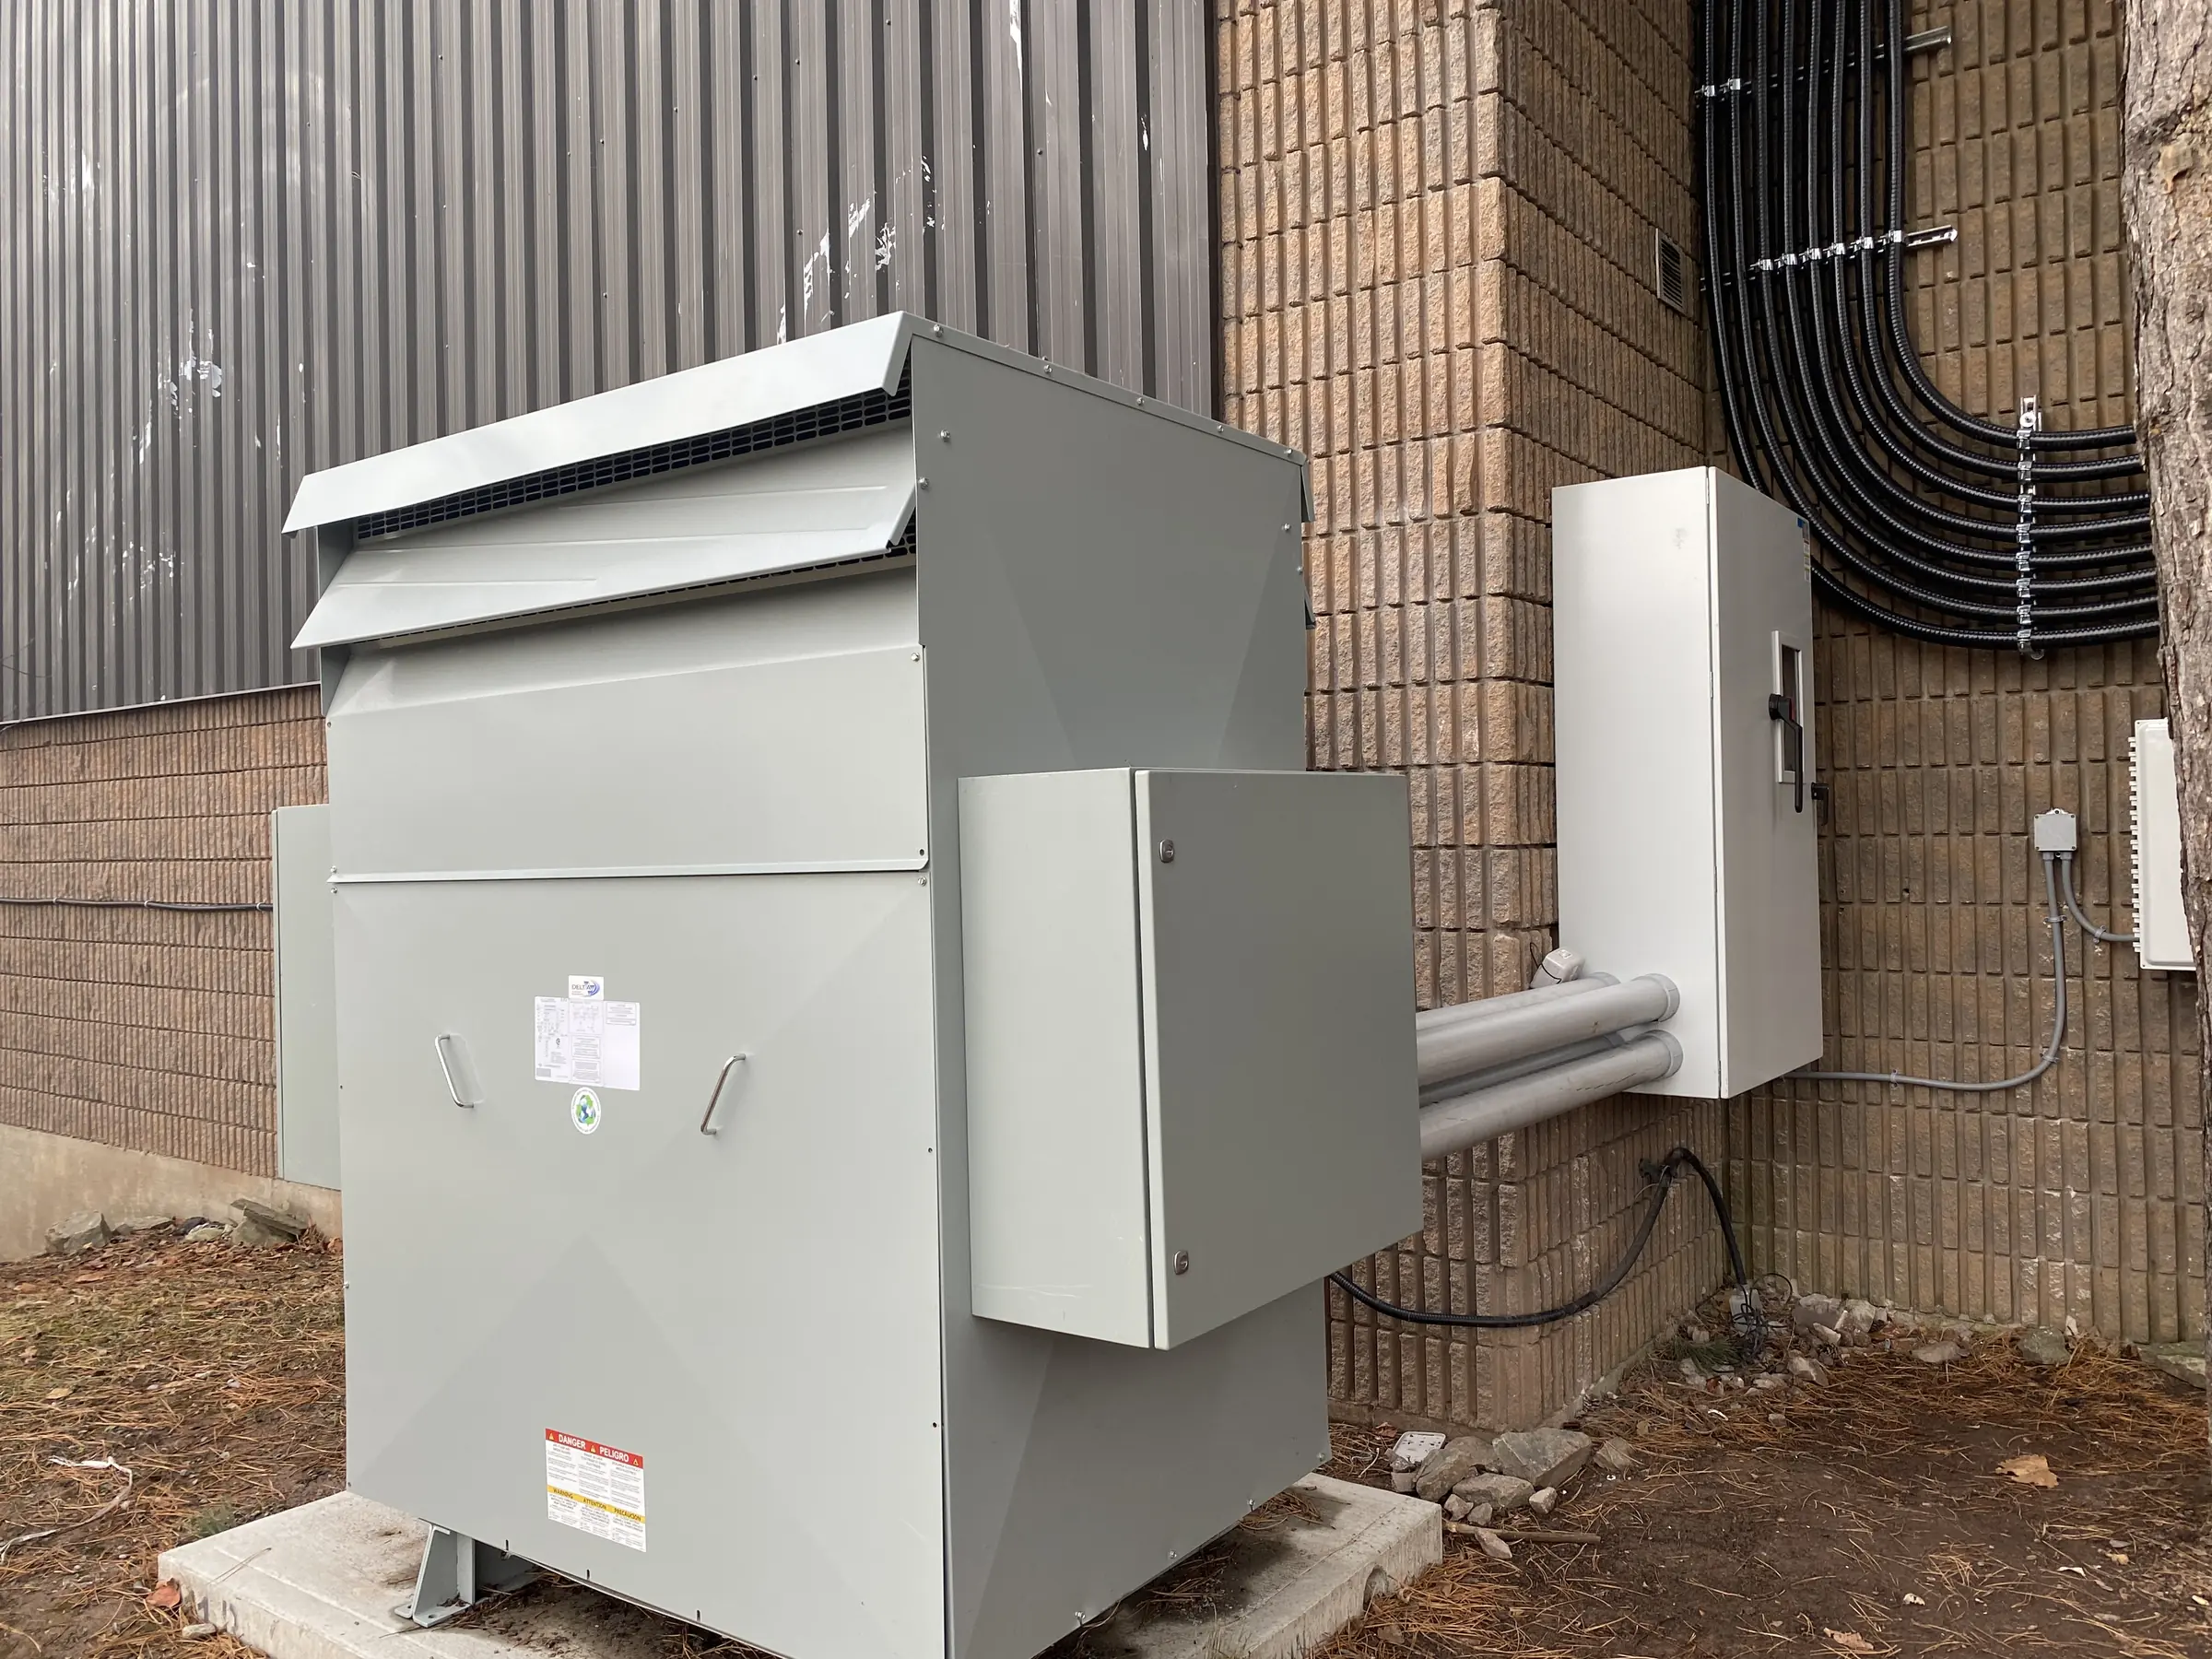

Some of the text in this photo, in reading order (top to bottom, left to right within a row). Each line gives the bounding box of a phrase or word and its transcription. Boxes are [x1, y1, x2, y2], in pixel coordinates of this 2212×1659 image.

[558, 1433, 629, 1463] DANGER PELIGRO
[553, 1488, 573, 1500] WARNING
